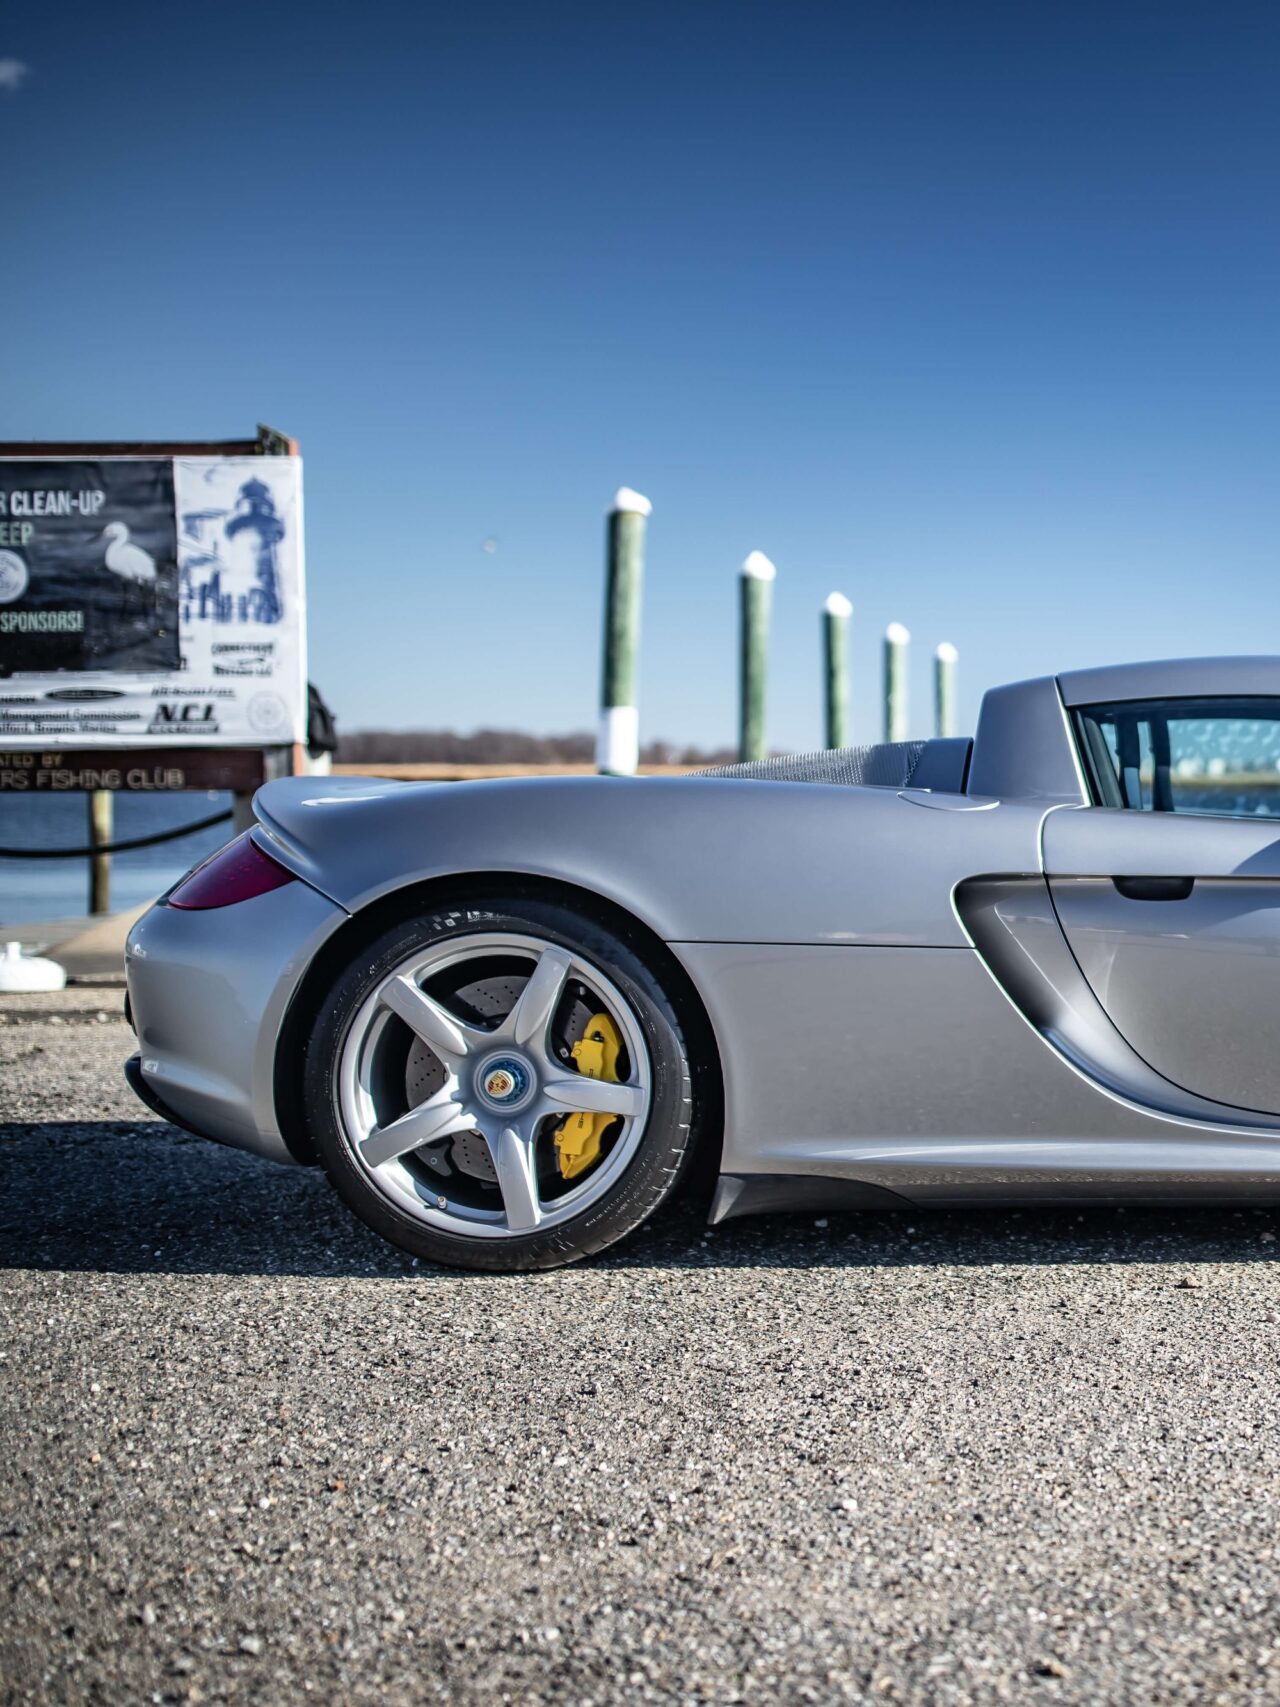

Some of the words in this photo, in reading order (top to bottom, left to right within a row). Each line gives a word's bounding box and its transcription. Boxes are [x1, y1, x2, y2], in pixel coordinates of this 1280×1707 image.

[10, 490, 105, 516] CLEAN-UP
[0, 611, 84, 633] SPONSORS!
[42, 753, 64, 767] BY
[37, 769, 121, 789] FISHING
[127, 768, 185, 789] CLUB
